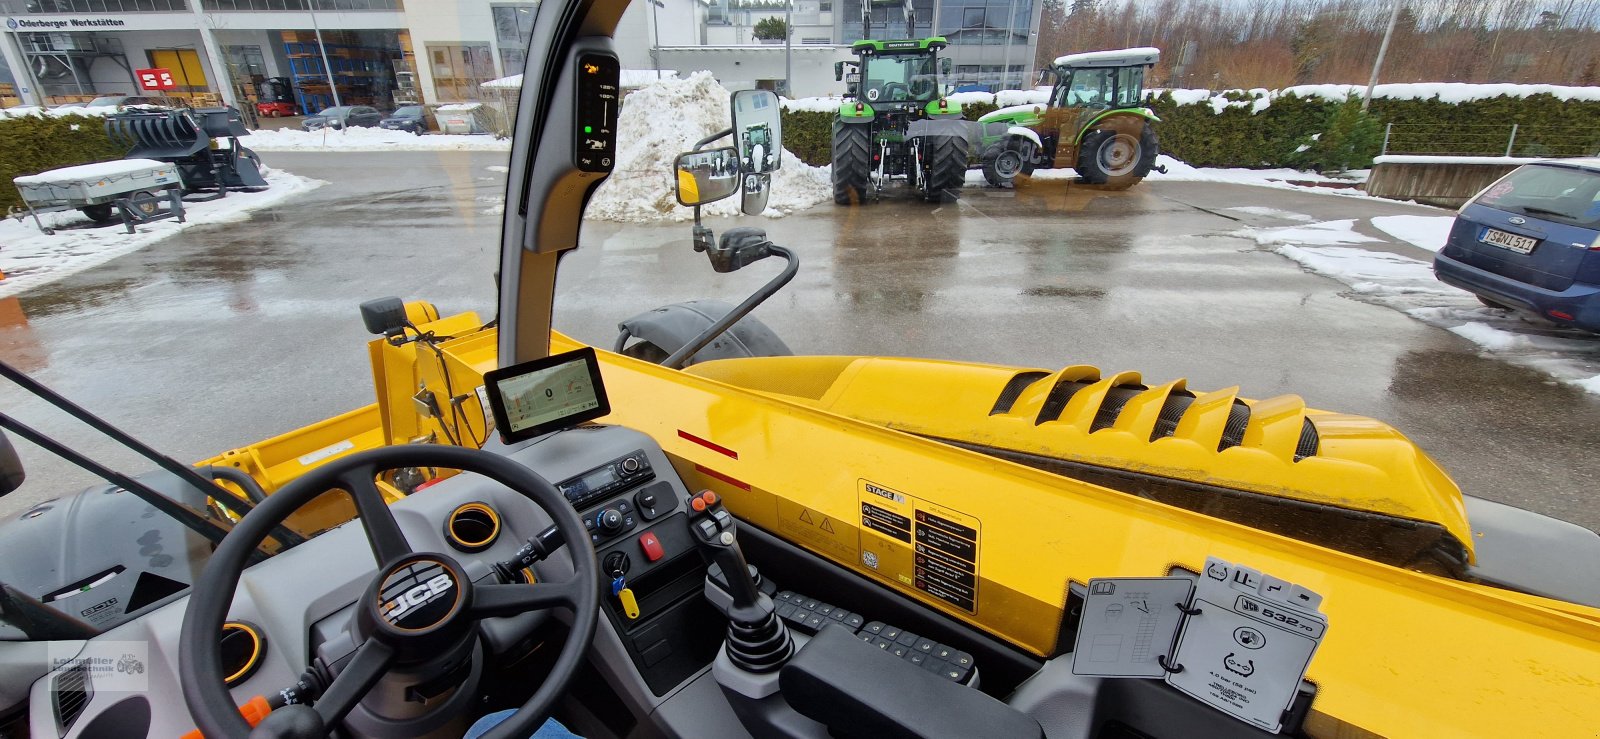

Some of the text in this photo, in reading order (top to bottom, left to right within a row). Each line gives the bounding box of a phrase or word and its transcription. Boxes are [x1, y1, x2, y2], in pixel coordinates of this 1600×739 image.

[19, 19, 67, 28] Oderberger
[1486, 230, 1499, 241] TS
[1513, 237, 1532, 250] 511
[545, 388, 553, 398] 0
[866, 484, 894, 500] STAGE
[388, 573, 454, 617] JCB
[1242, 599, 1313, 632] JCB 532 70
